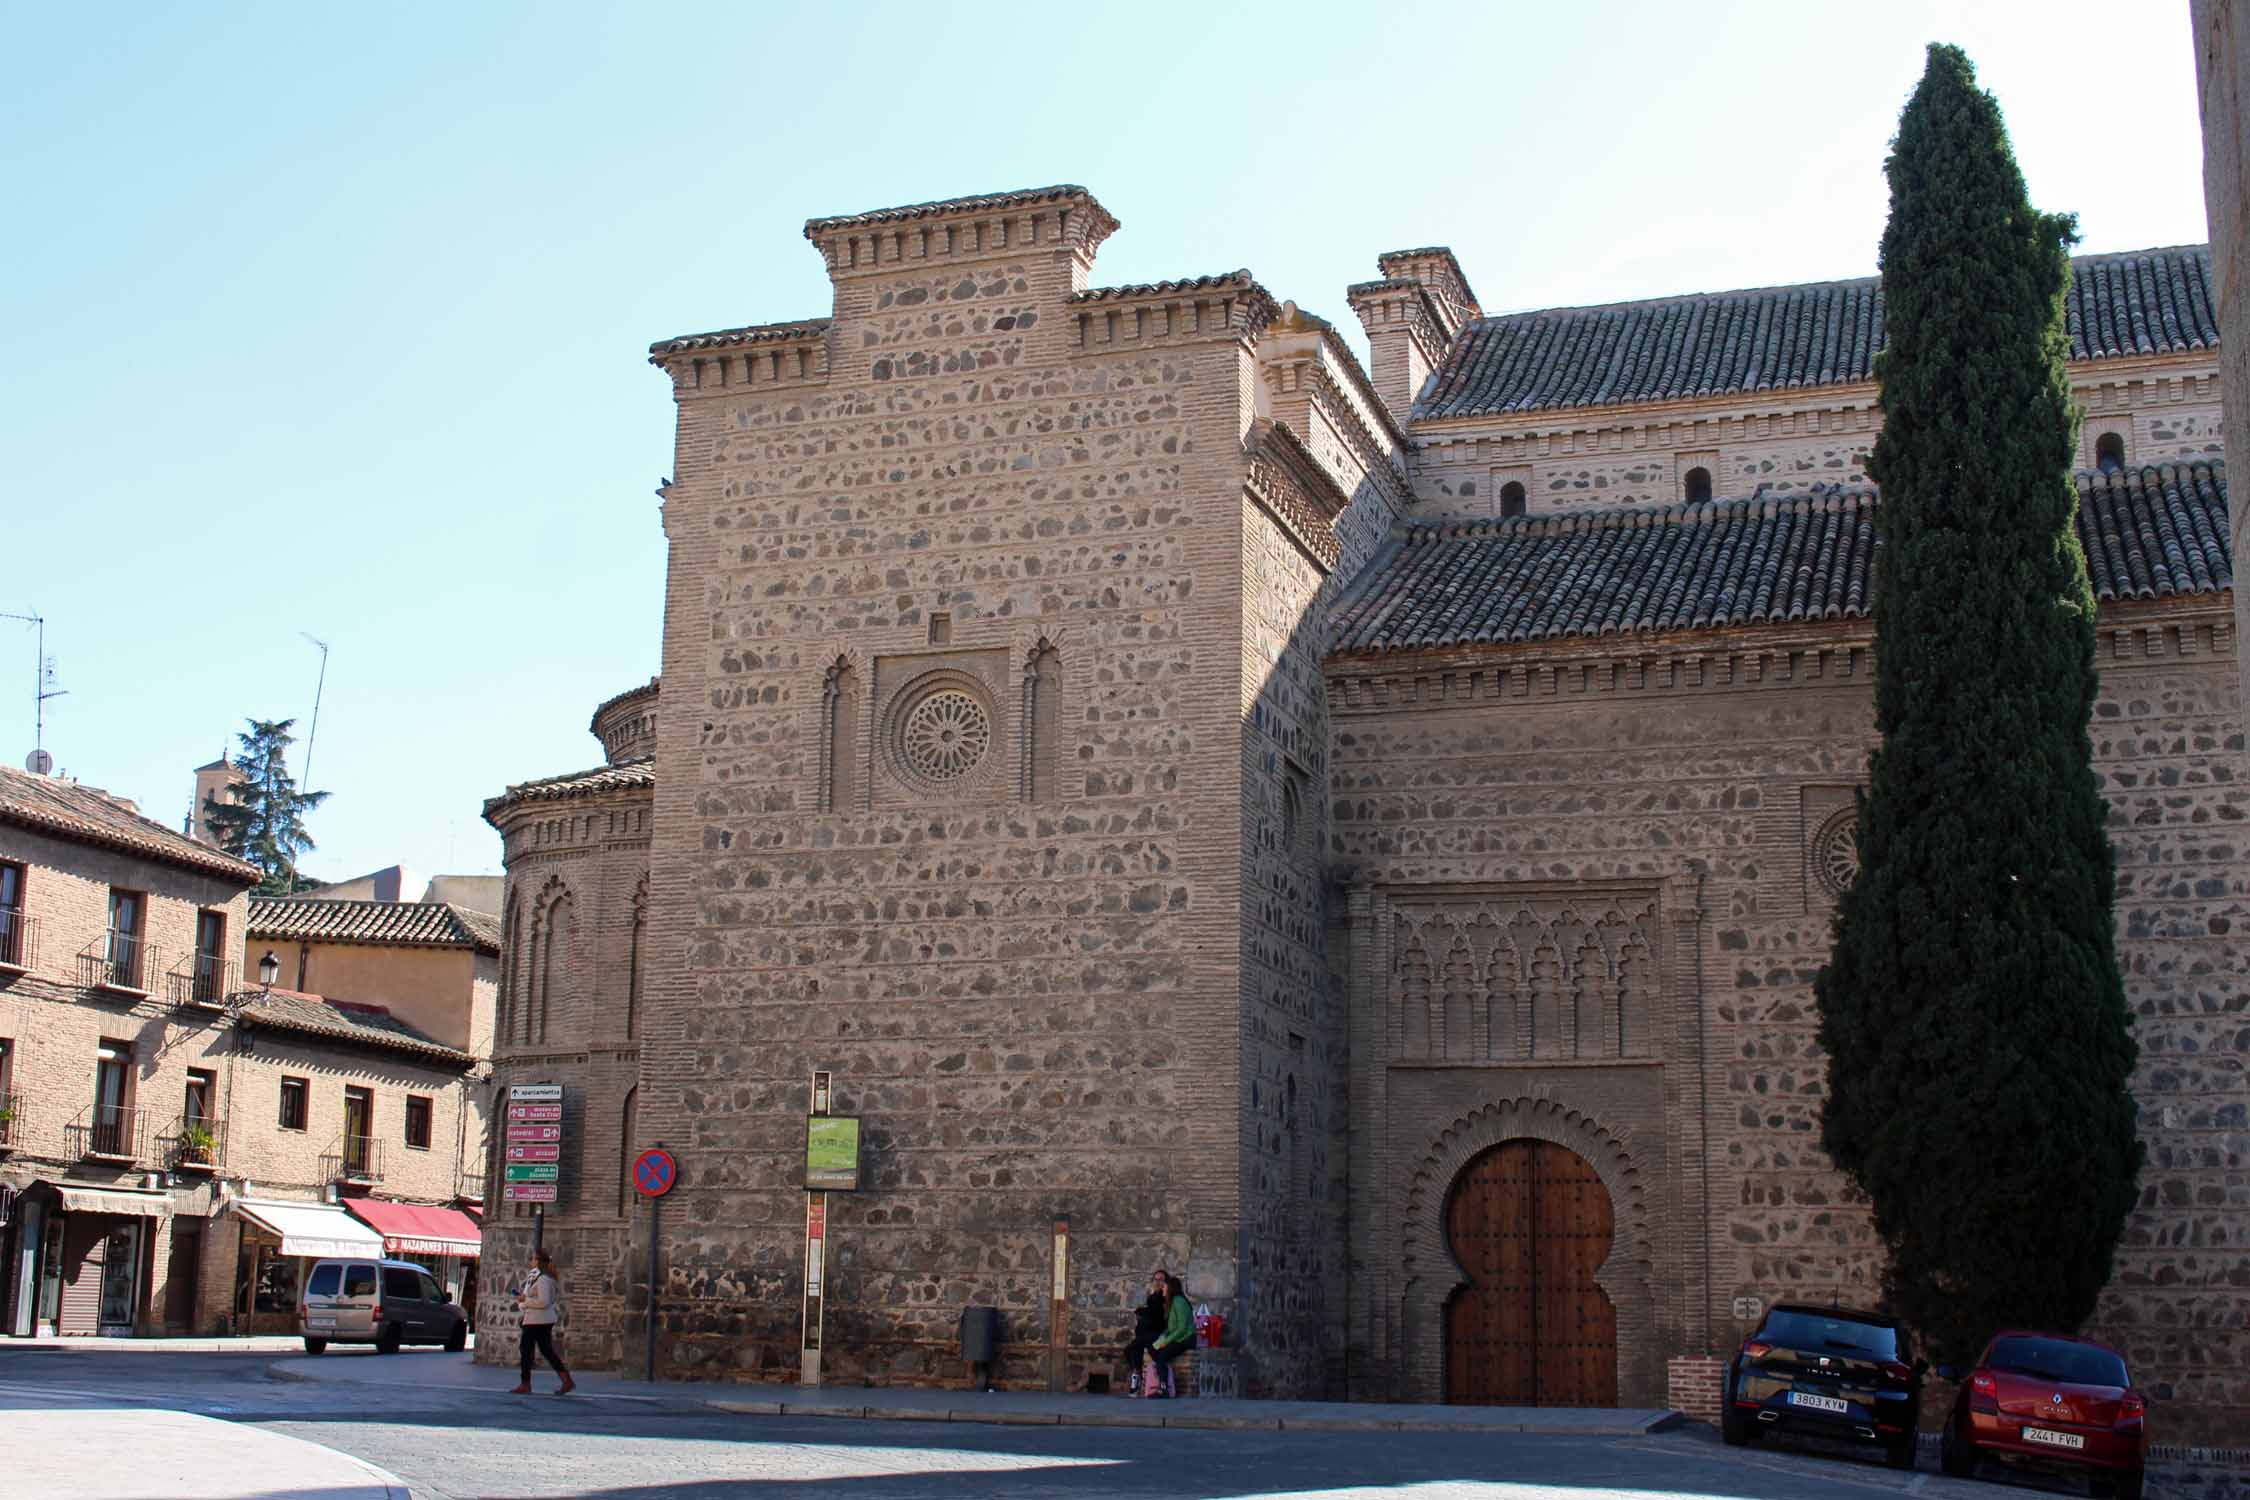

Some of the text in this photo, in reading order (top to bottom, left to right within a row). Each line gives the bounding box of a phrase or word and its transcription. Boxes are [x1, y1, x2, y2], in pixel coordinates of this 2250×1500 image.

[1796, 1394, 1821, 1406] 3803
[2031, 1430, 2077, 1446] 2441 FVH
